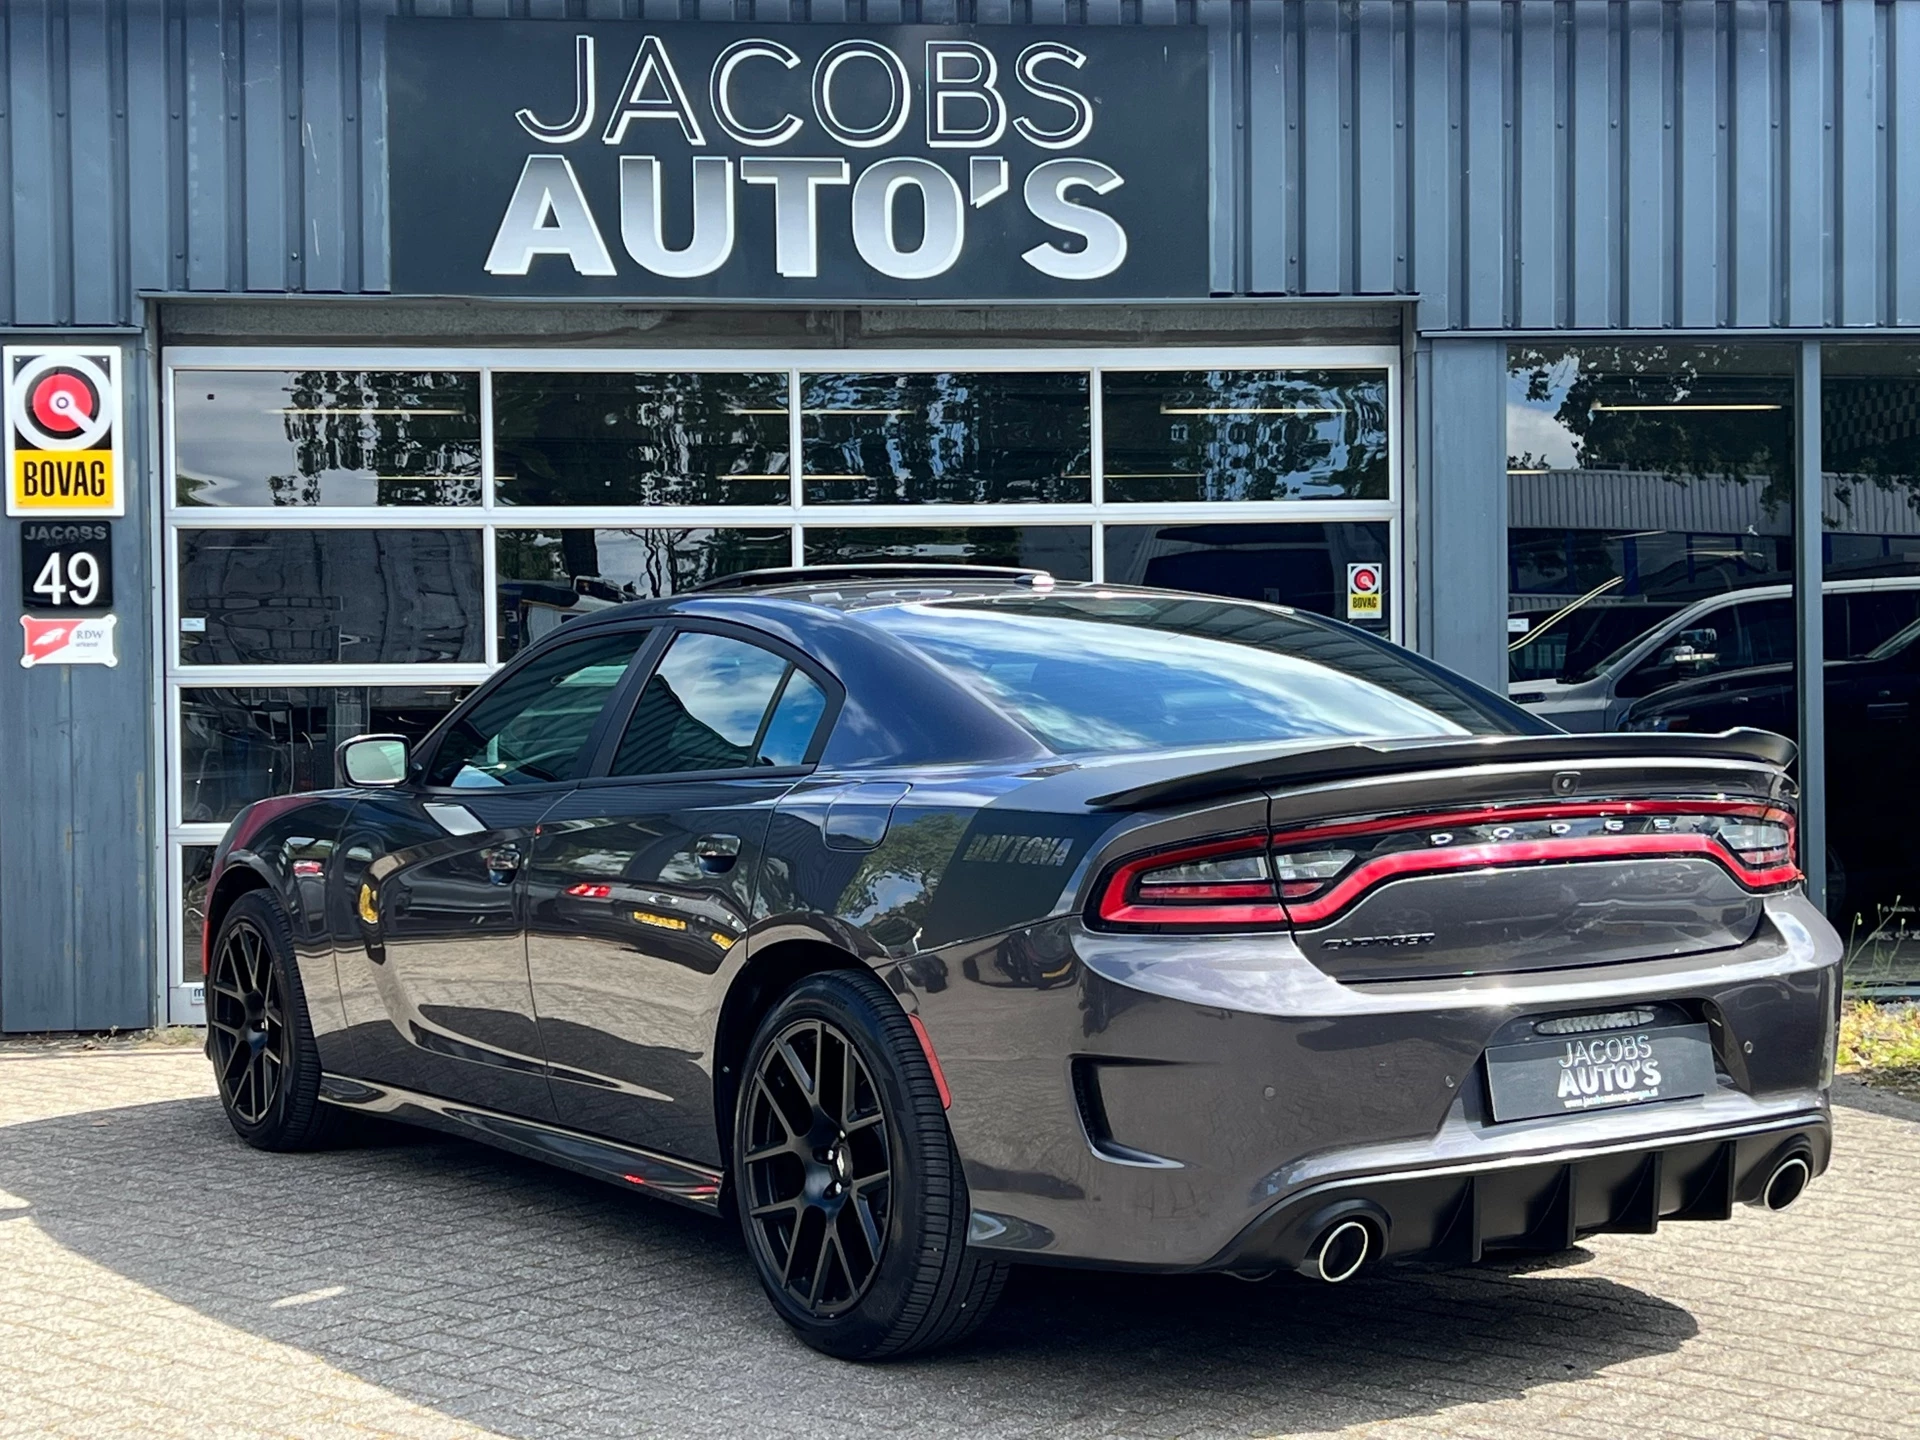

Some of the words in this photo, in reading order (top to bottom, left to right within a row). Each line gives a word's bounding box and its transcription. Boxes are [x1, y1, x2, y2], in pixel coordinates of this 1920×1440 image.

[515, 34, 1094, 150] JACOBS
[484, 154, 1128, 281] AUTO'S
[23, 460, 105, 497] BOVAG
[23, 525, 108, 541] JACOBS
[33, 551, 100, 606] 49
[1352, 596, 1377, 609] BOVAG
[76, 630, 105, 640] RDW
[1430, 818, 1672, 846] DODGE
[962, 833, 1075, 867] DAYTONA
[1558, 1034, 1653, 1068] JACOBS
[1557, 1059, 1662, 1098] AUTO'S
